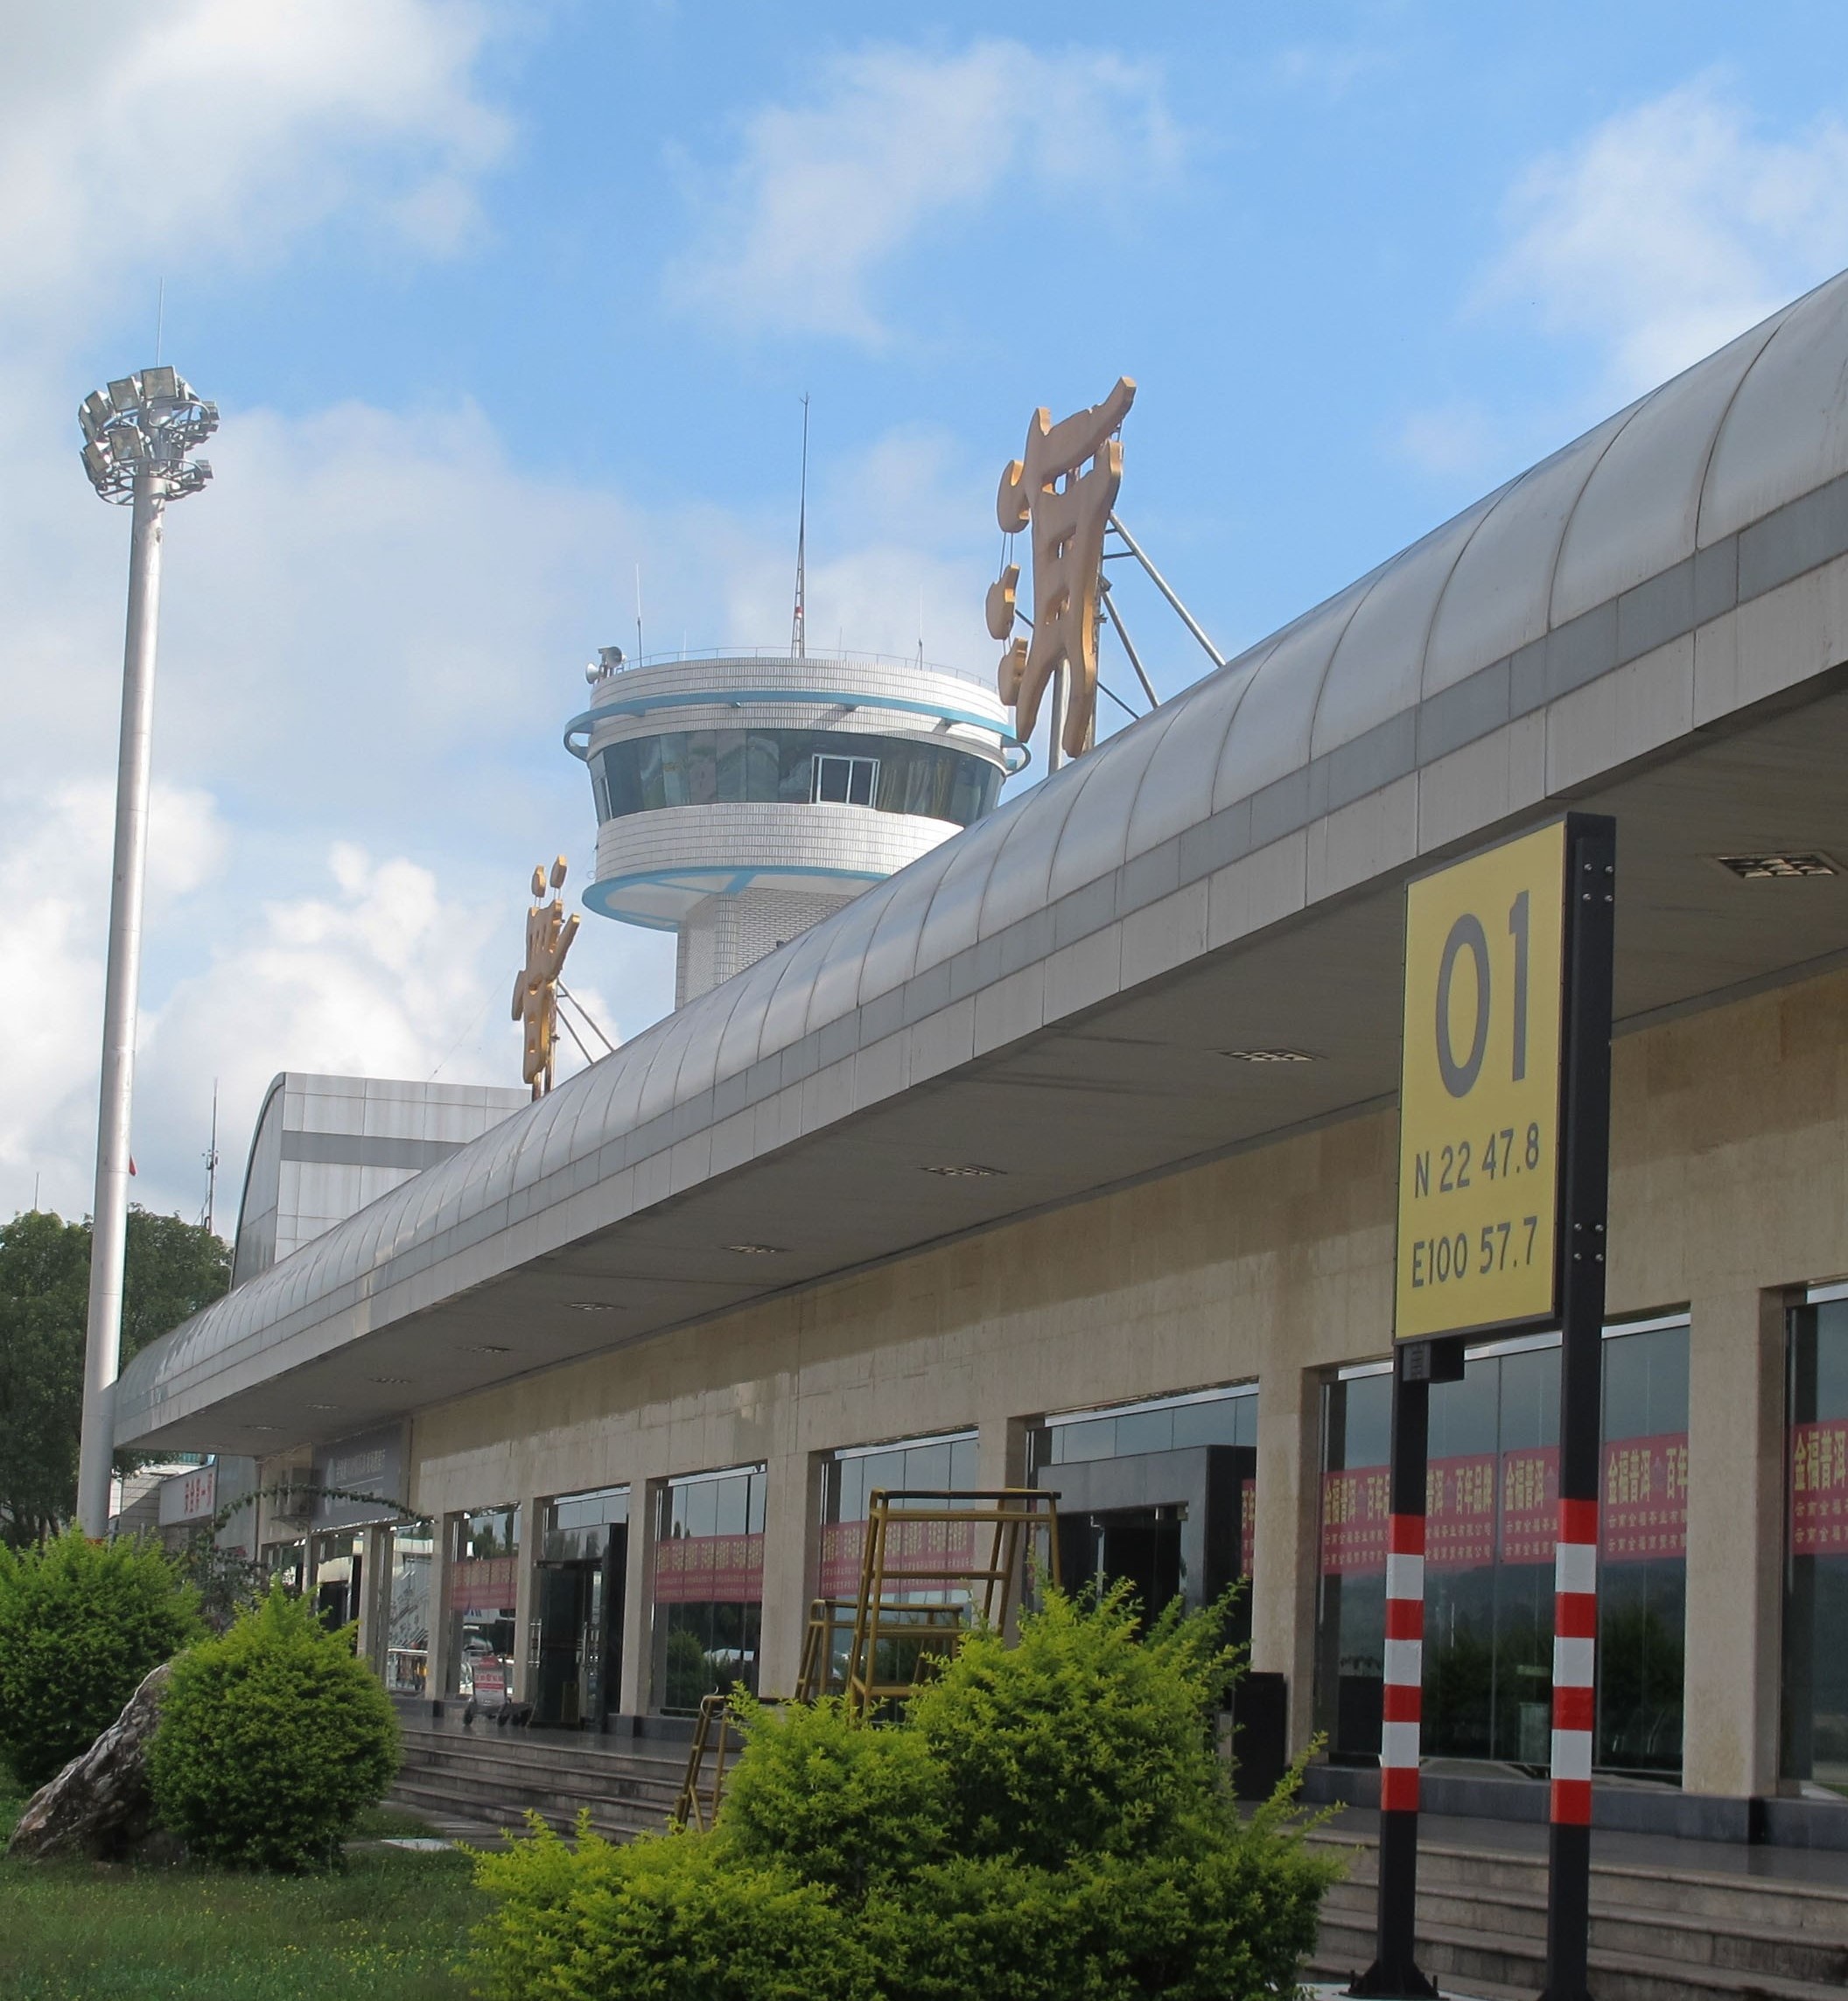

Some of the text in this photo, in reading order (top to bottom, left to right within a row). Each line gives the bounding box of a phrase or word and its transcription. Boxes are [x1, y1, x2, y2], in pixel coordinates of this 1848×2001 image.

[1435, 890, 1530, 1099] 01
[1414, 1122, 1539, 1199] N 22 47.8
[1411, 1215, 1538, 1288] E100 57.7
